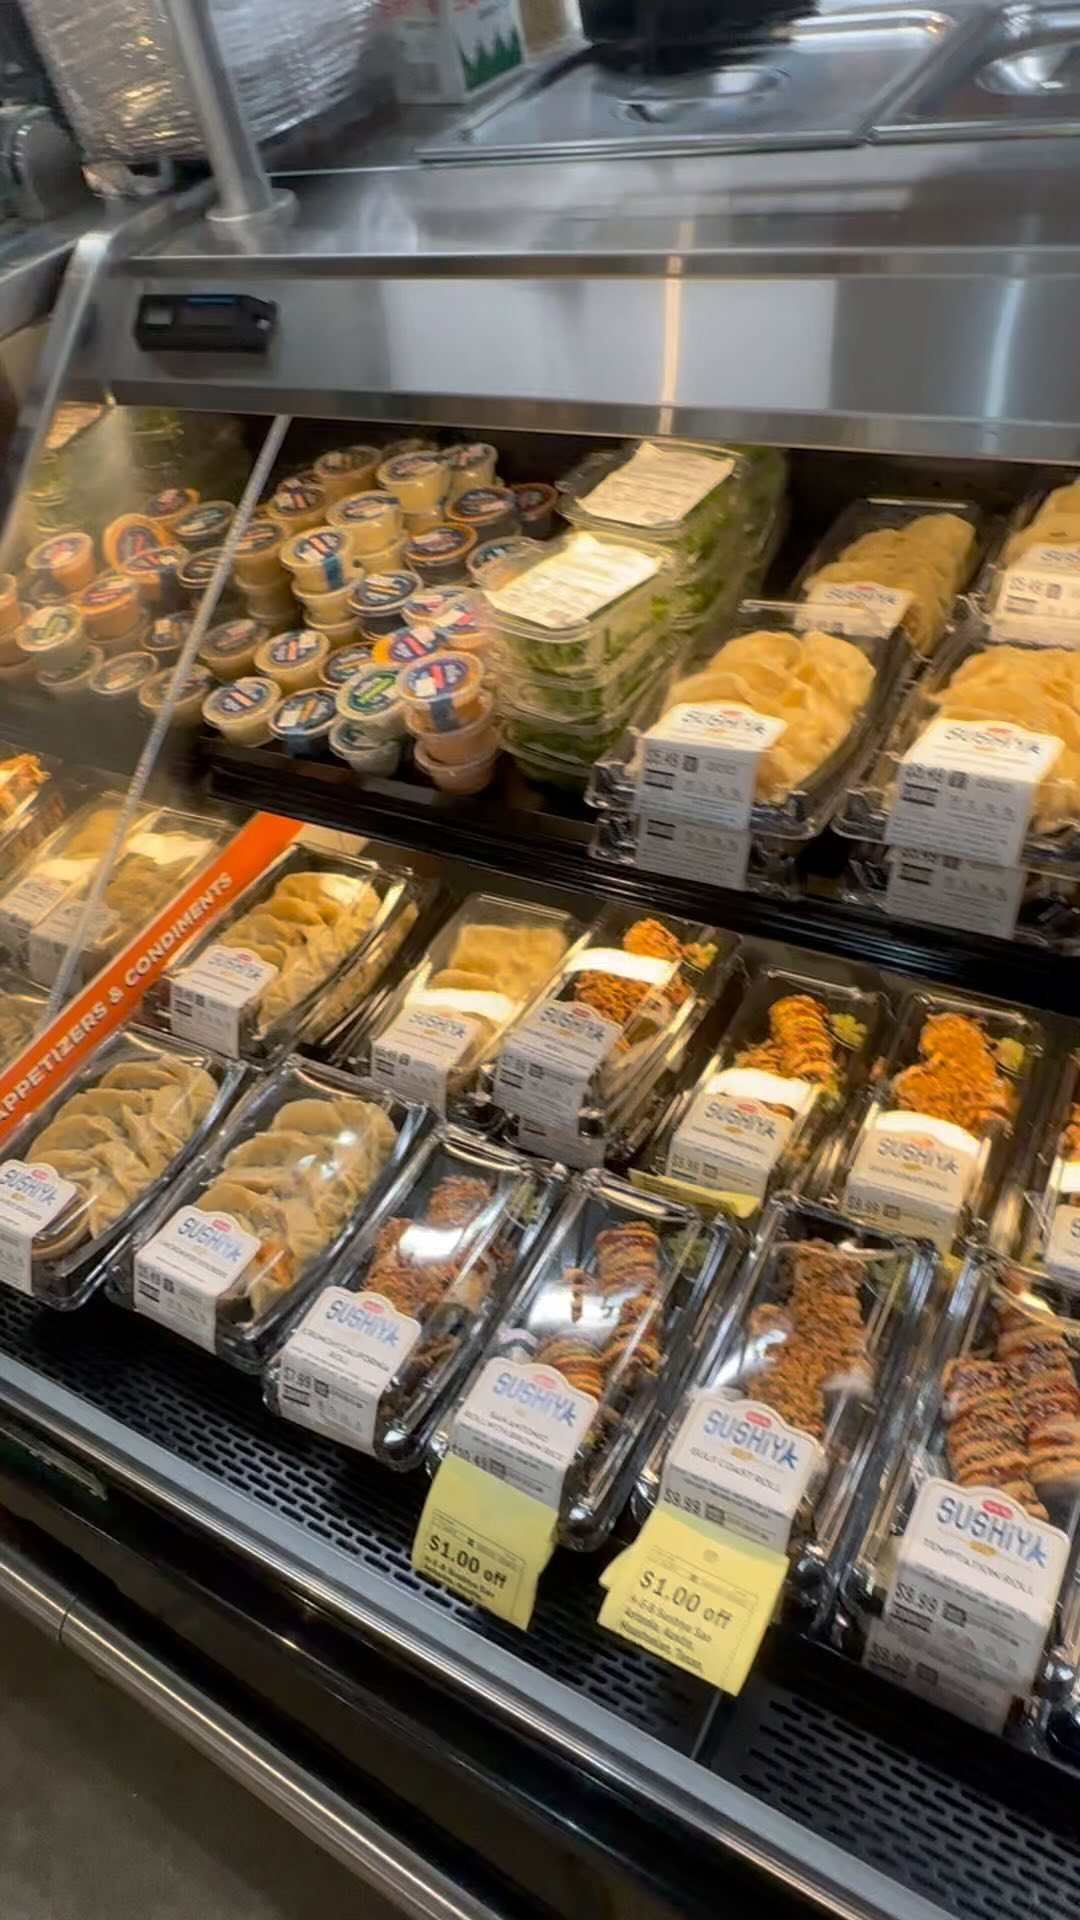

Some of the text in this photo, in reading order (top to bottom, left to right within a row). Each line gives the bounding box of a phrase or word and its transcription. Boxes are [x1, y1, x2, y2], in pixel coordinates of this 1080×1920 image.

[108, 986, 124, 1004] &
[125, 872, 233, 988] CONDIMENTS
[427, 1534, 481, 1574] $1.00
[484, 1567, 509, 1590] off
[640, 1569, 701, 1613] $1.00
[703, 1607, 733, 1630] off
